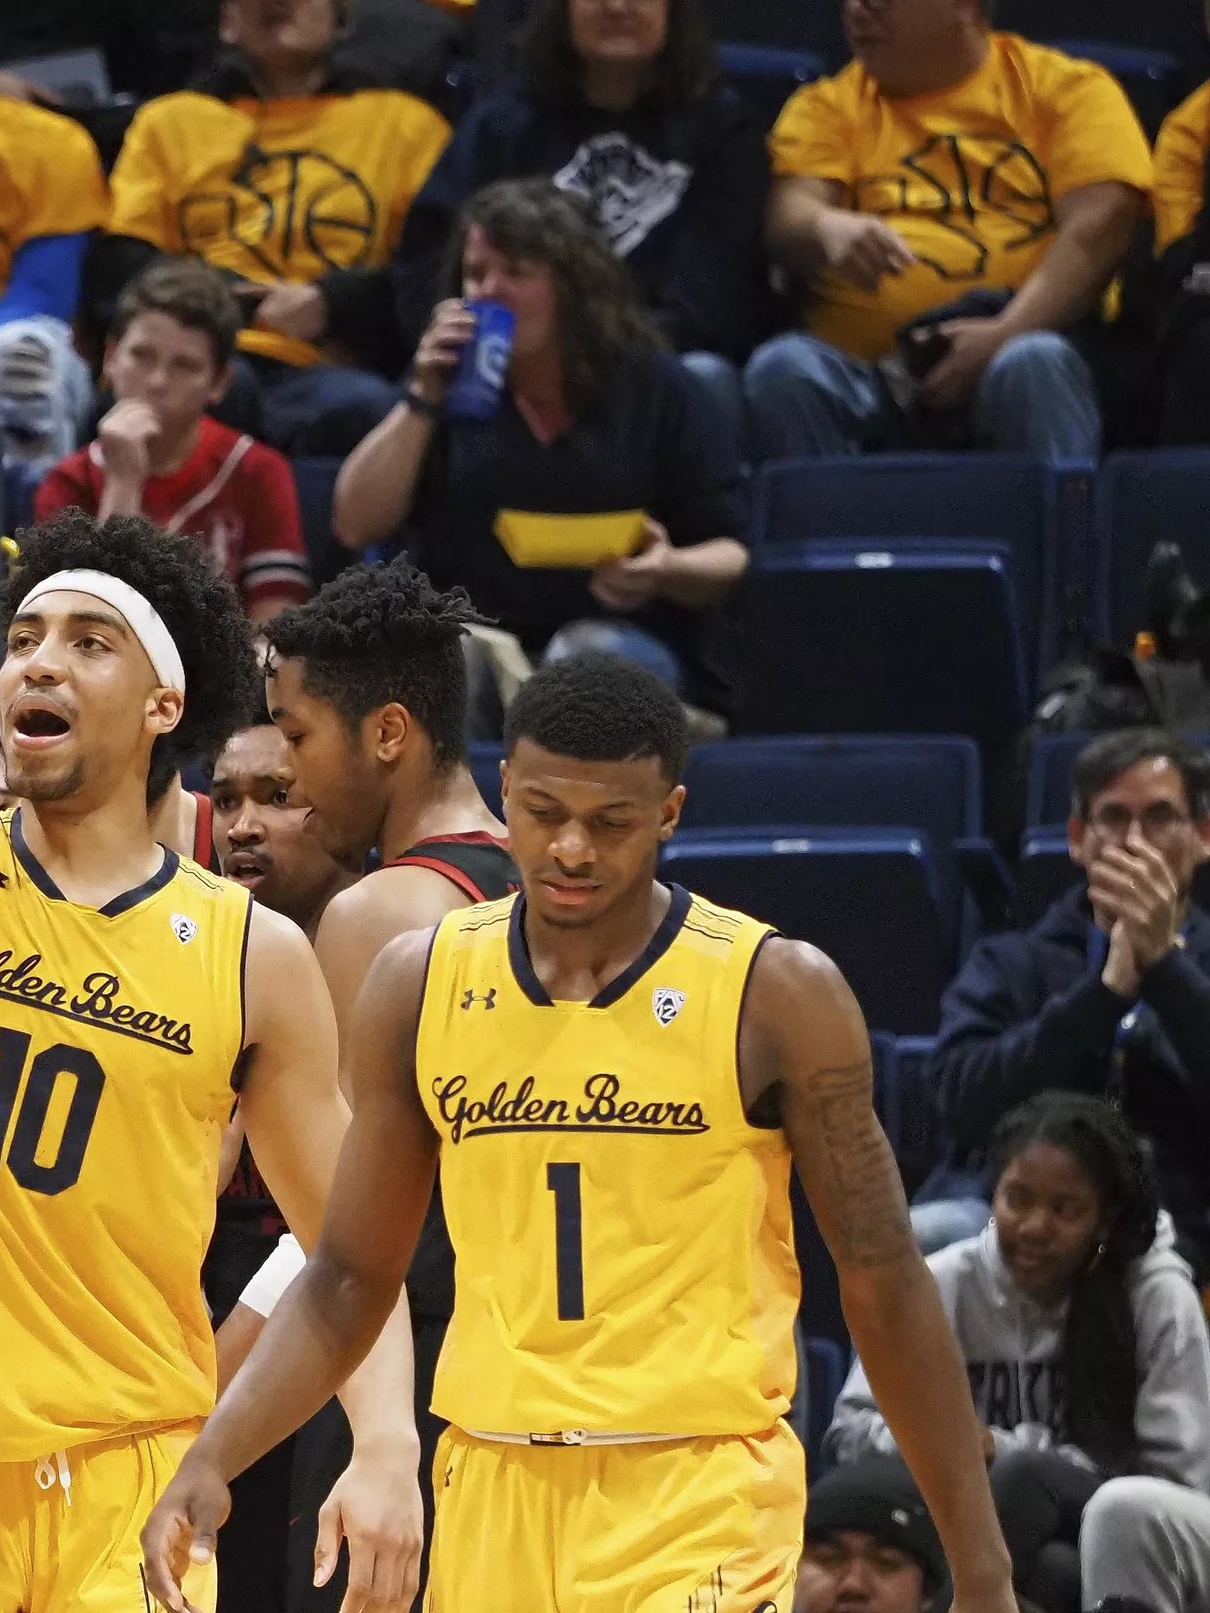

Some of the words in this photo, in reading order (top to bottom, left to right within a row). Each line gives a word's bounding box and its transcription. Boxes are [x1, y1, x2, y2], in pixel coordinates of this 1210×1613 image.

[70, 972, 194, 1053] Bears
[432, 1075, 570, 1145] Golden
[575, 1073, 708, 1128] Bears
[546, 1162, 585, 1321] 1
